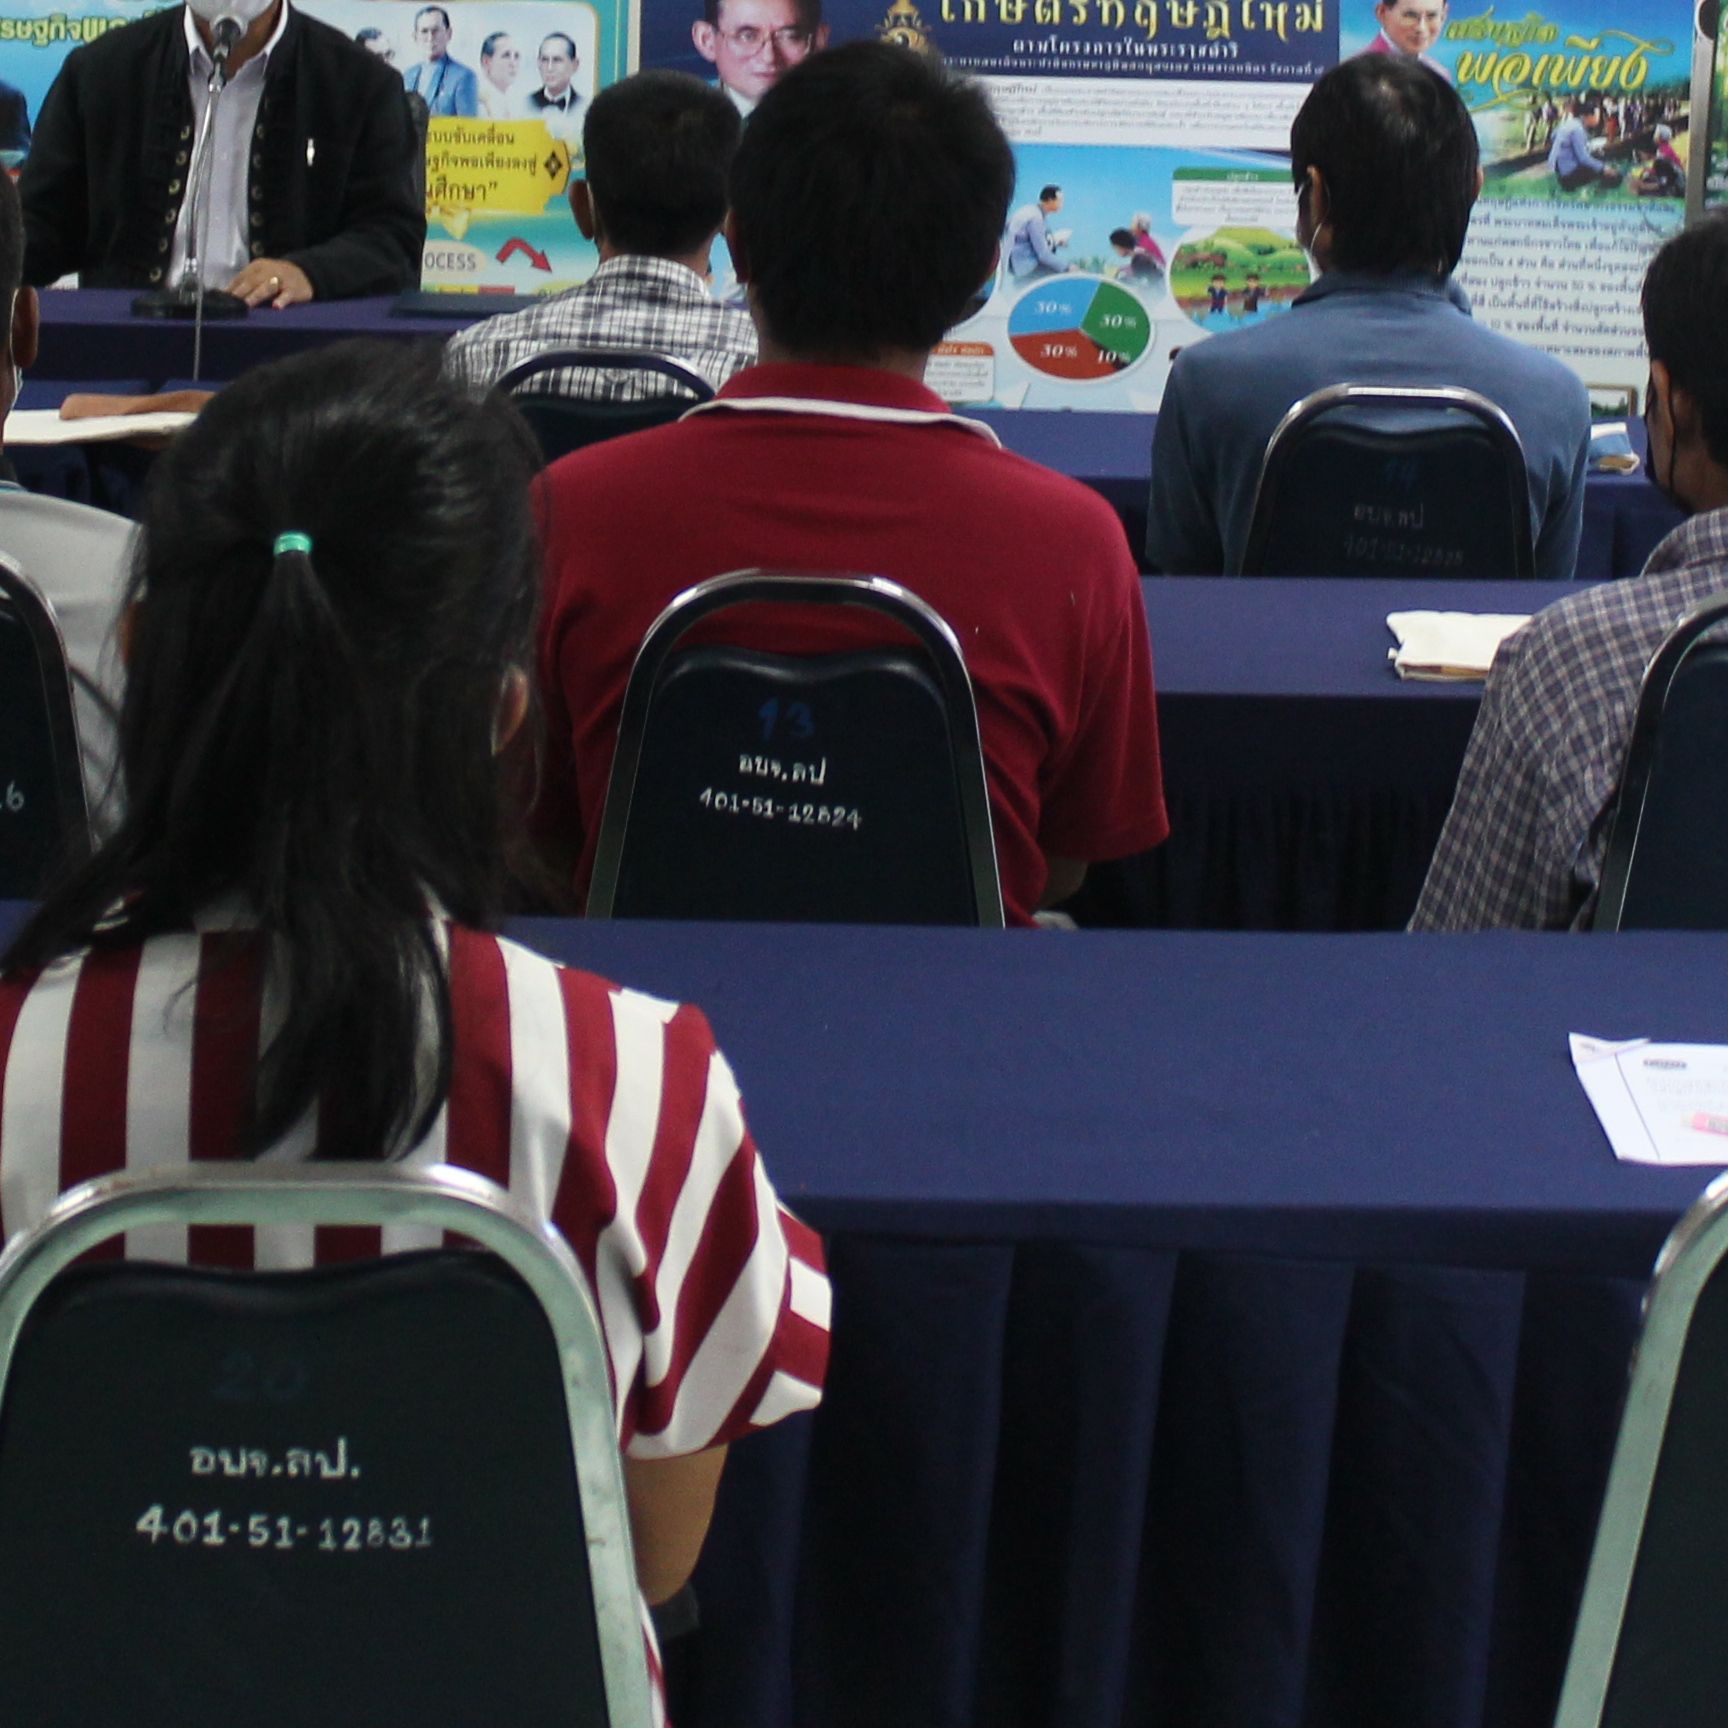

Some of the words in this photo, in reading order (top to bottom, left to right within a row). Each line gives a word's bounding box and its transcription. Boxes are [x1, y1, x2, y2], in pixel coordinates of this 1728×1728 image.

[1456, 29, 1672, 100] พอเพียง
[188, 1436, 362, 1479] อบจ.ลป.
[136, 1503, 433, 1550] 401-51-12831
